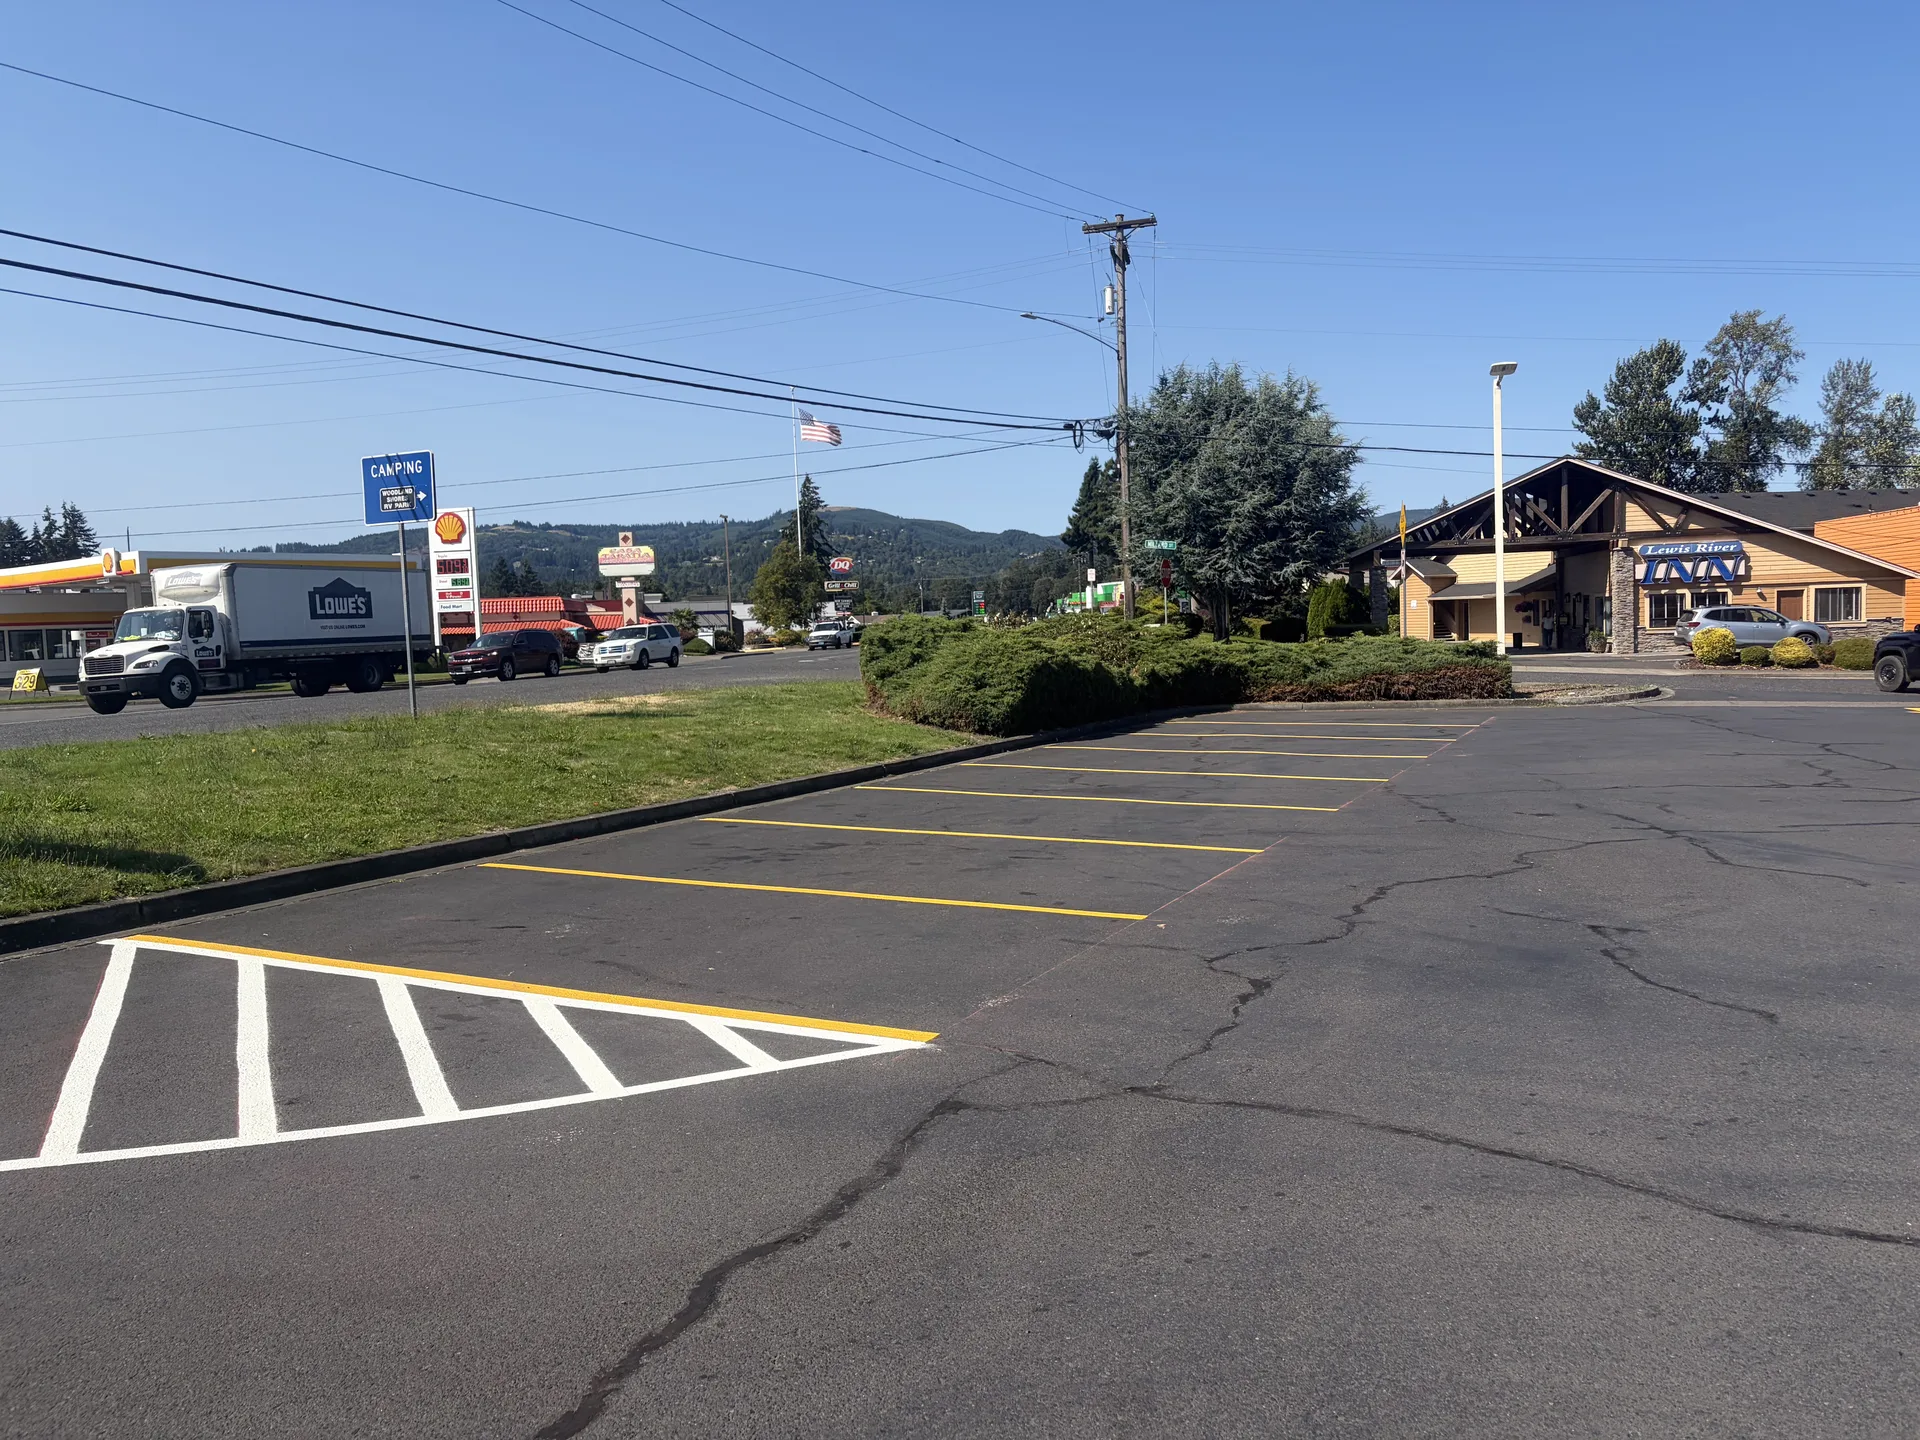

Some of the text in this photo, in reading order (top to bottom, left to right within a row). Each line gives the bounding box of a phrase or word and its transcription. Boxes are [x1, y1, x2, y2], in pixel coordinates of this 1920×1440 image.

[370, 459, 423, 478] CAMPING
[382, 488, 413, 496] WOODLAND
[386, 495, 409, 503] SHORES
[394, 501, 412, 509] PARK
[1645, 543, 1738, 555] Lewis River
[834, 560, 850, 570] DQ
[1638, 554, 1744, 585] INN
[315, 593, 367, 614] LOWE'S
